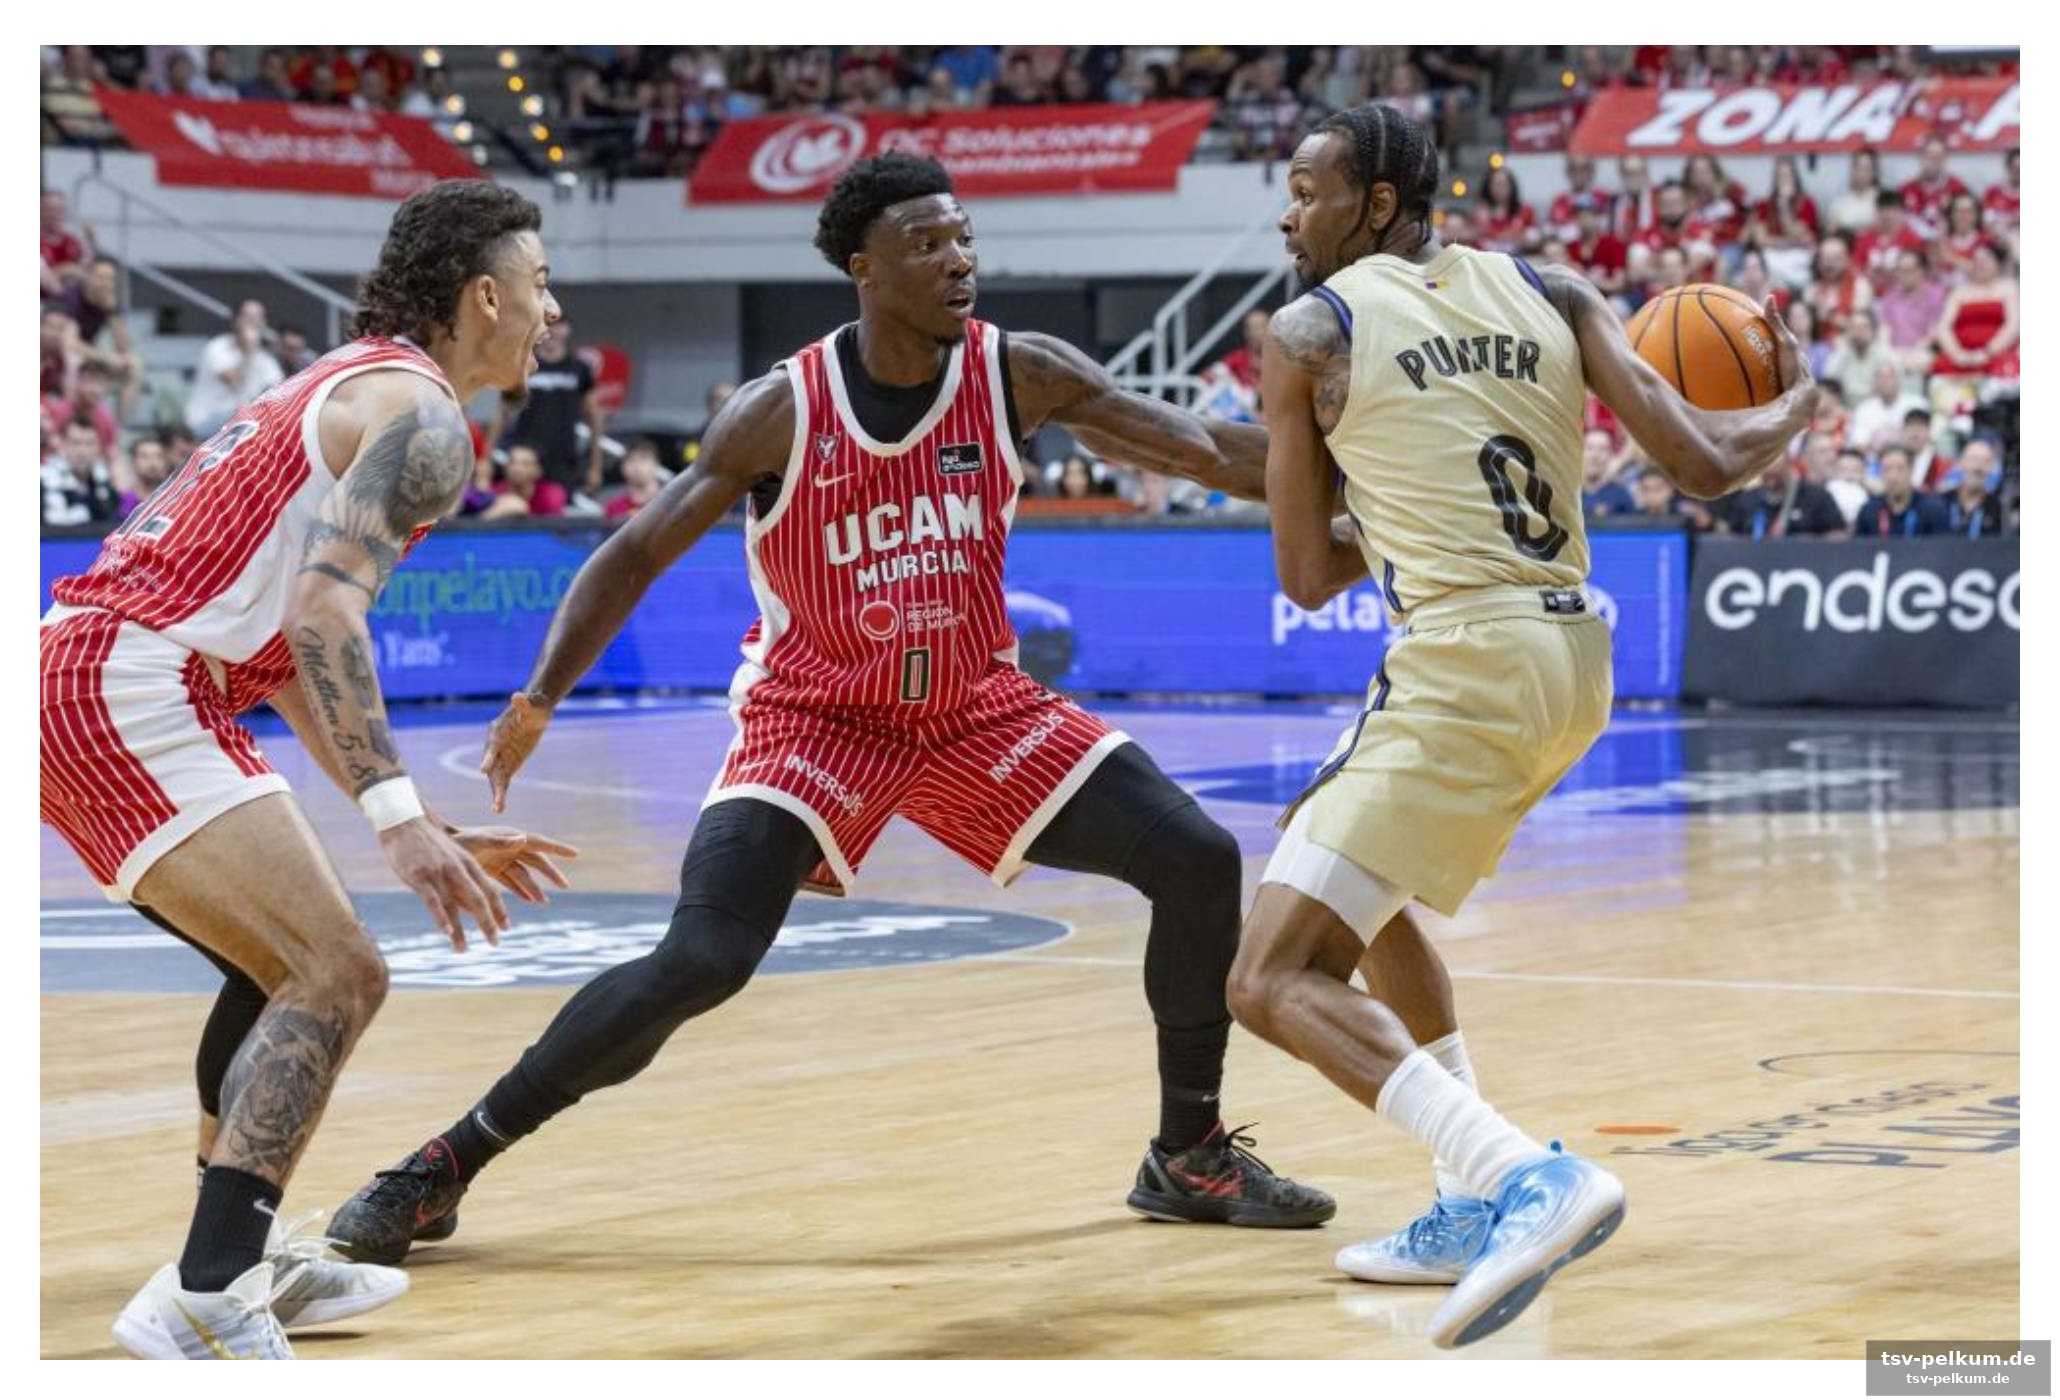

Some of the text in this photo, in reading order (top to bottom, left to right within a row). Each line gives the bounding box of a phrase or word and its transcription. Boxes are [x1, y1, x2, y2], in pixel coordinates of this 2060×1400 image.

[1626, 83, 1902, 146] ZONA
[824, 493, 985, 567] UCAM
[1478, 434, 1569, 562] 0
[857, 550, 969, 592] MURCIA
[1272, 589, 1402, 646] pela
[988, 710, 1065, 785] INVERSUS
[784, 753, 864, 818] INVERSUS
